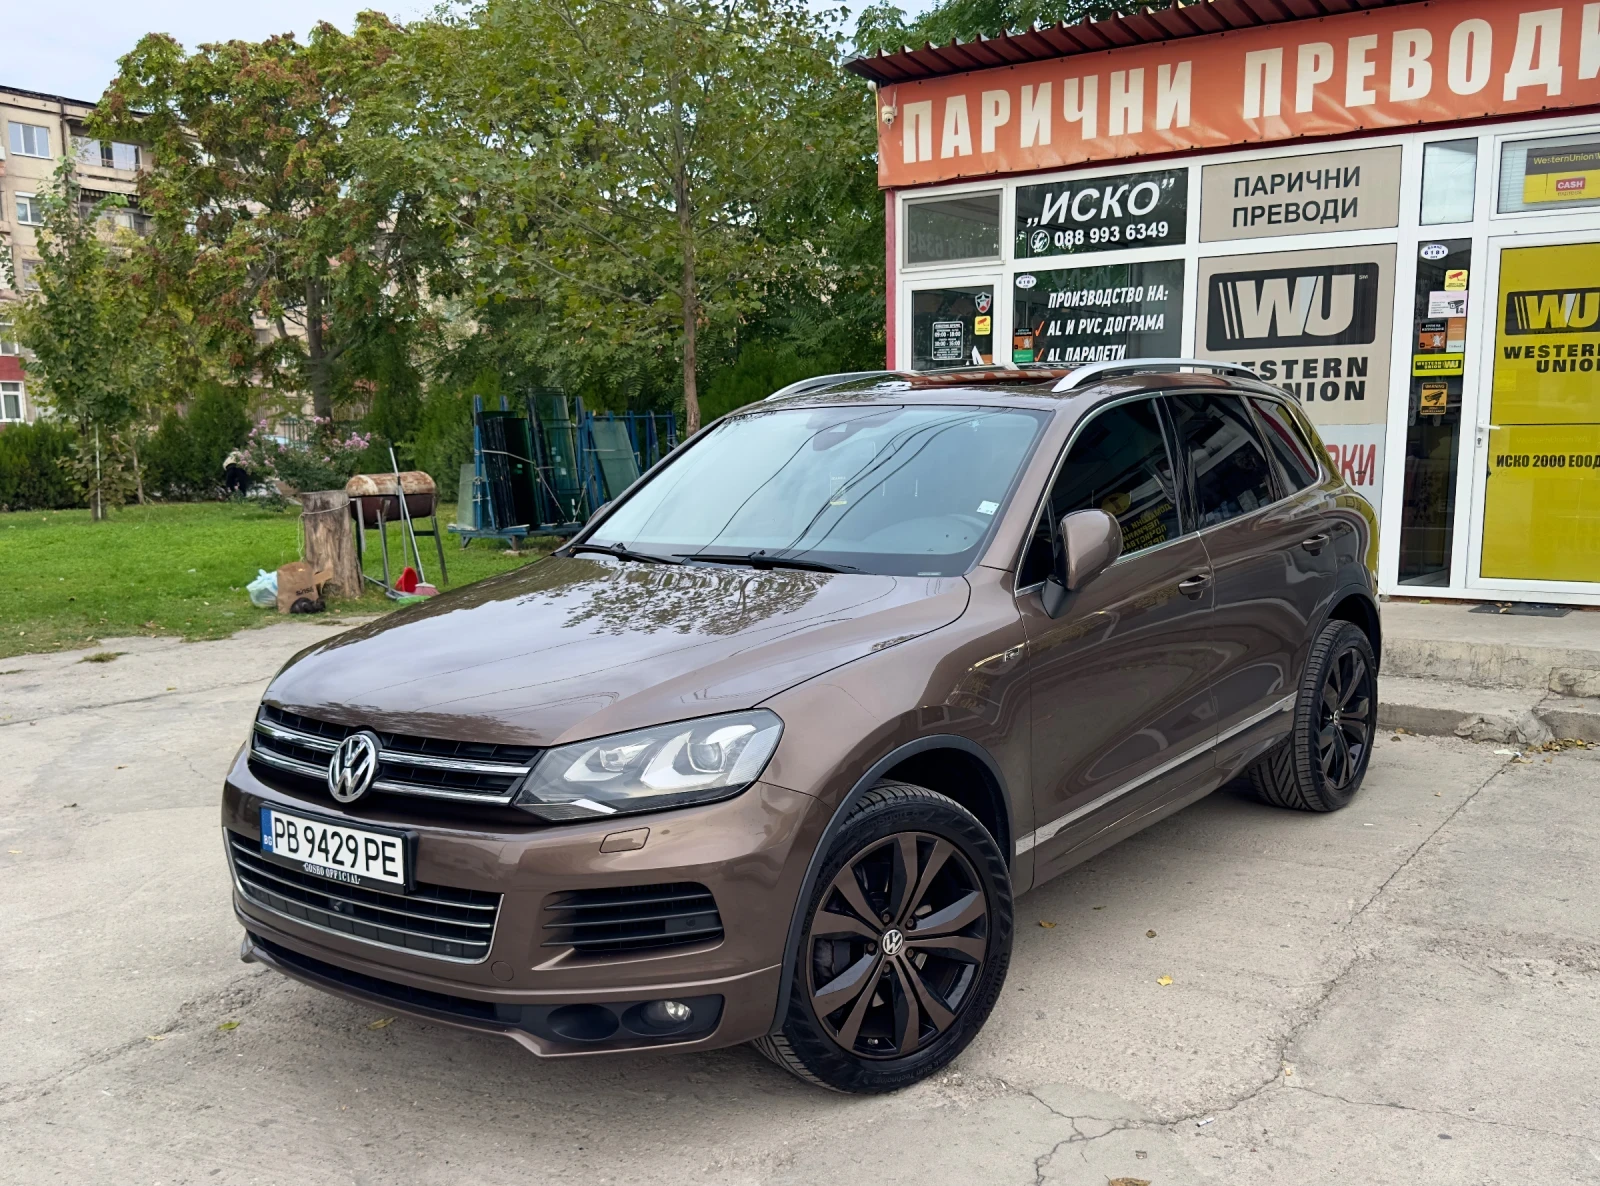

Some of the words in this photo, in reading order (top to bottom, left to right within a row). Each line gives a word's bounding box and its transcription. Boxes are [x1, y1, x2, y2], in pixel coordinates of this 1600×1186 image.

[902, 60, 1192, 164] ПАРИЧНИ
[1233, 166, 1361, 198] ПАРИЧНИ
[1557, 180, 1583, 190] CASH
[1232, 197, 1359, 227] ПРЕВОДИ
[1054, 229, 1085, 248] 088
[1090, 225, 1121, 244] 993
[1125, 221, 1169, 241] 6349
[1047, 288, 1143, 309] ПРОИЗВОДСТВО
[1147, 284, 1169, 302] НА:
[1235, 273, 1356, 339] WU
[1525, 292, 1599, 329] WU
[1065, 319, 1075, 336] И
[1077, 317, 1102, 335] PVC
[1103, 313, 1165, 336] ДОГРАМА
[1064, 344, 1127, 362] ПАРАПЕТИ
[1503, 343, 1600, 360] WESTER
[1536, 358, 1600, 373] UNIO
[1272, 380, 1366, 402] NION
[1496, 454, 1530, 468] ИСКО
[1532, 454, 1566, 468] 2000
[263, 834, 273, 846] BG
[274, 816, 300, 854] PB
[303, 825, 359, 869] 9429
[364, 836, 399, 878] PE
[325, 867, 361, 885] OFFICIAL
